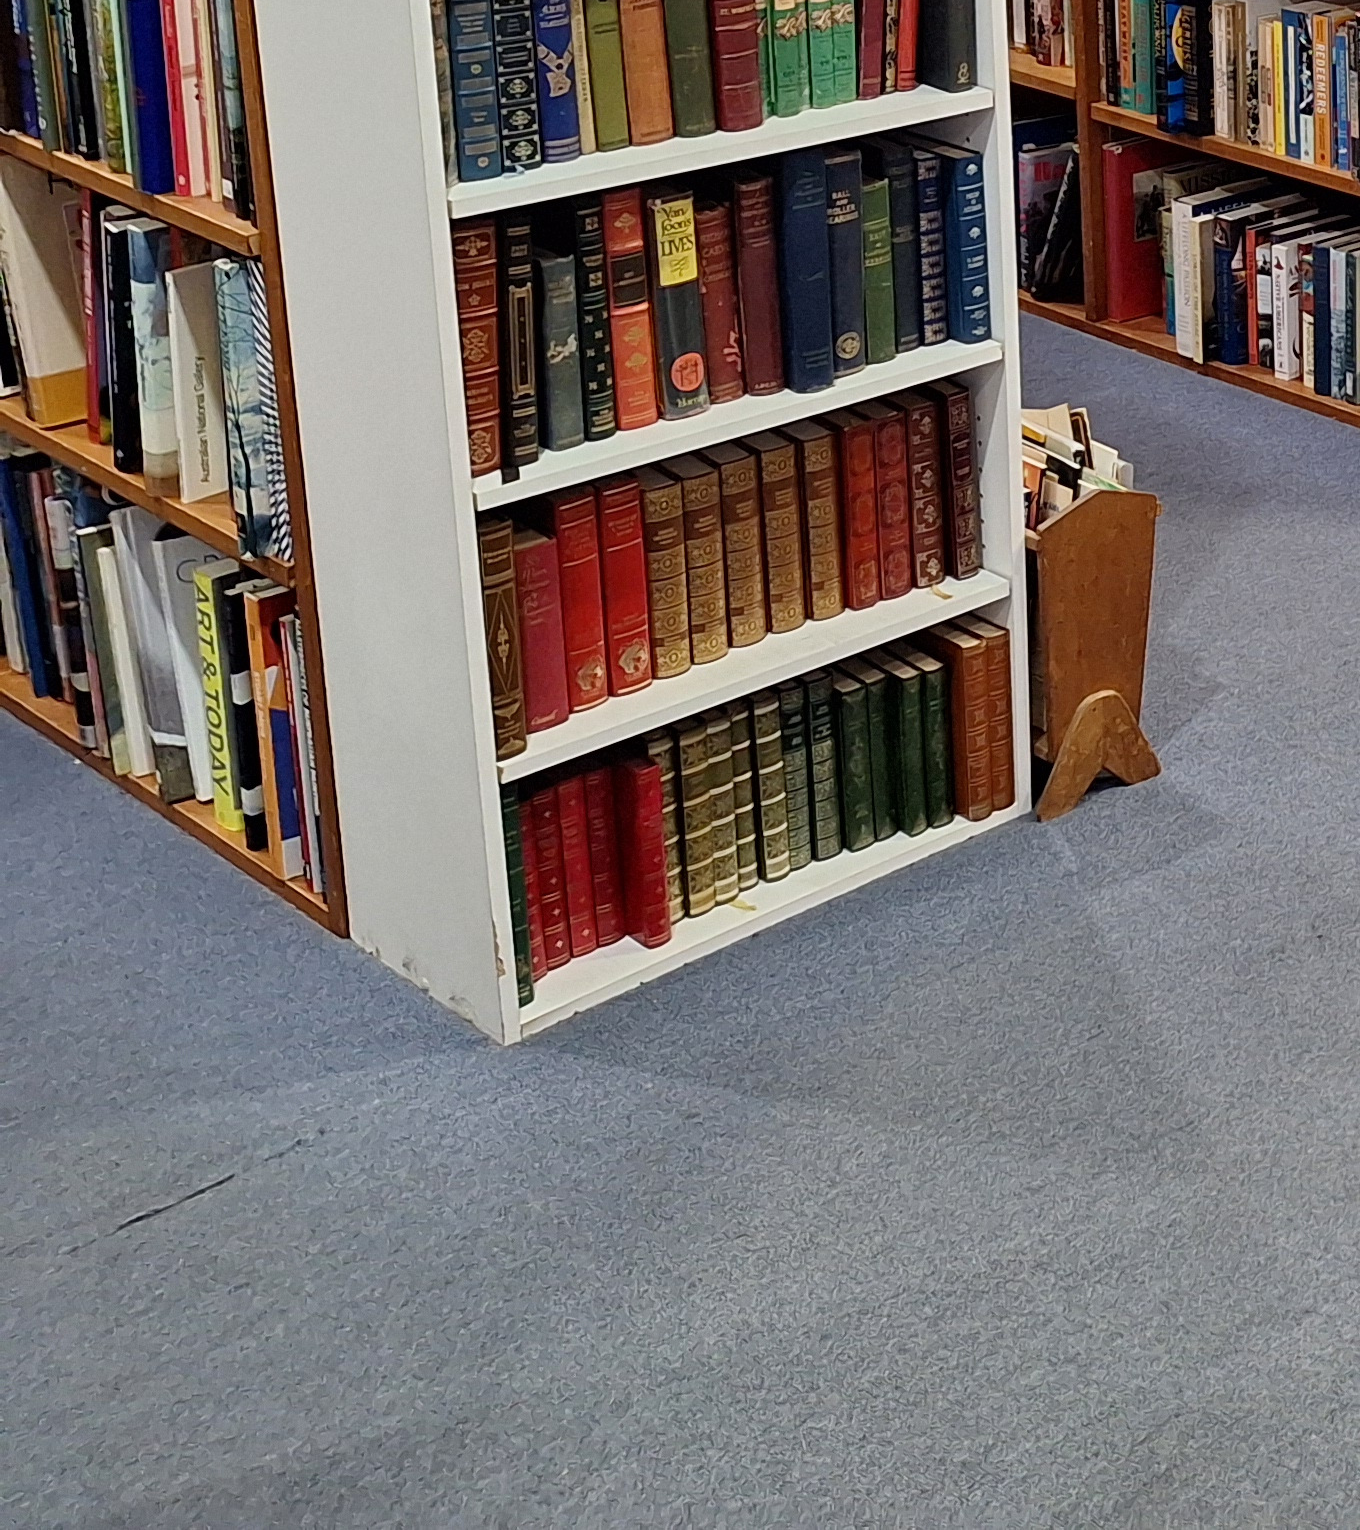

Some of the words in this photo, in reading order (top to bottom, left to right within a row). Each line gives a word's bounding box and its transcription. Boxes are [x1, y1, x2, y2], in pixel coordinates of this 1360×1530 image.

[1314, 43, 1327, 116] REDEEMERS
[660, 234, 694, 257] LIVES
[195, 585, 218, 660] ART
[201, 664, 220, 691] &
[204, 694, 232, 798] TODAY
